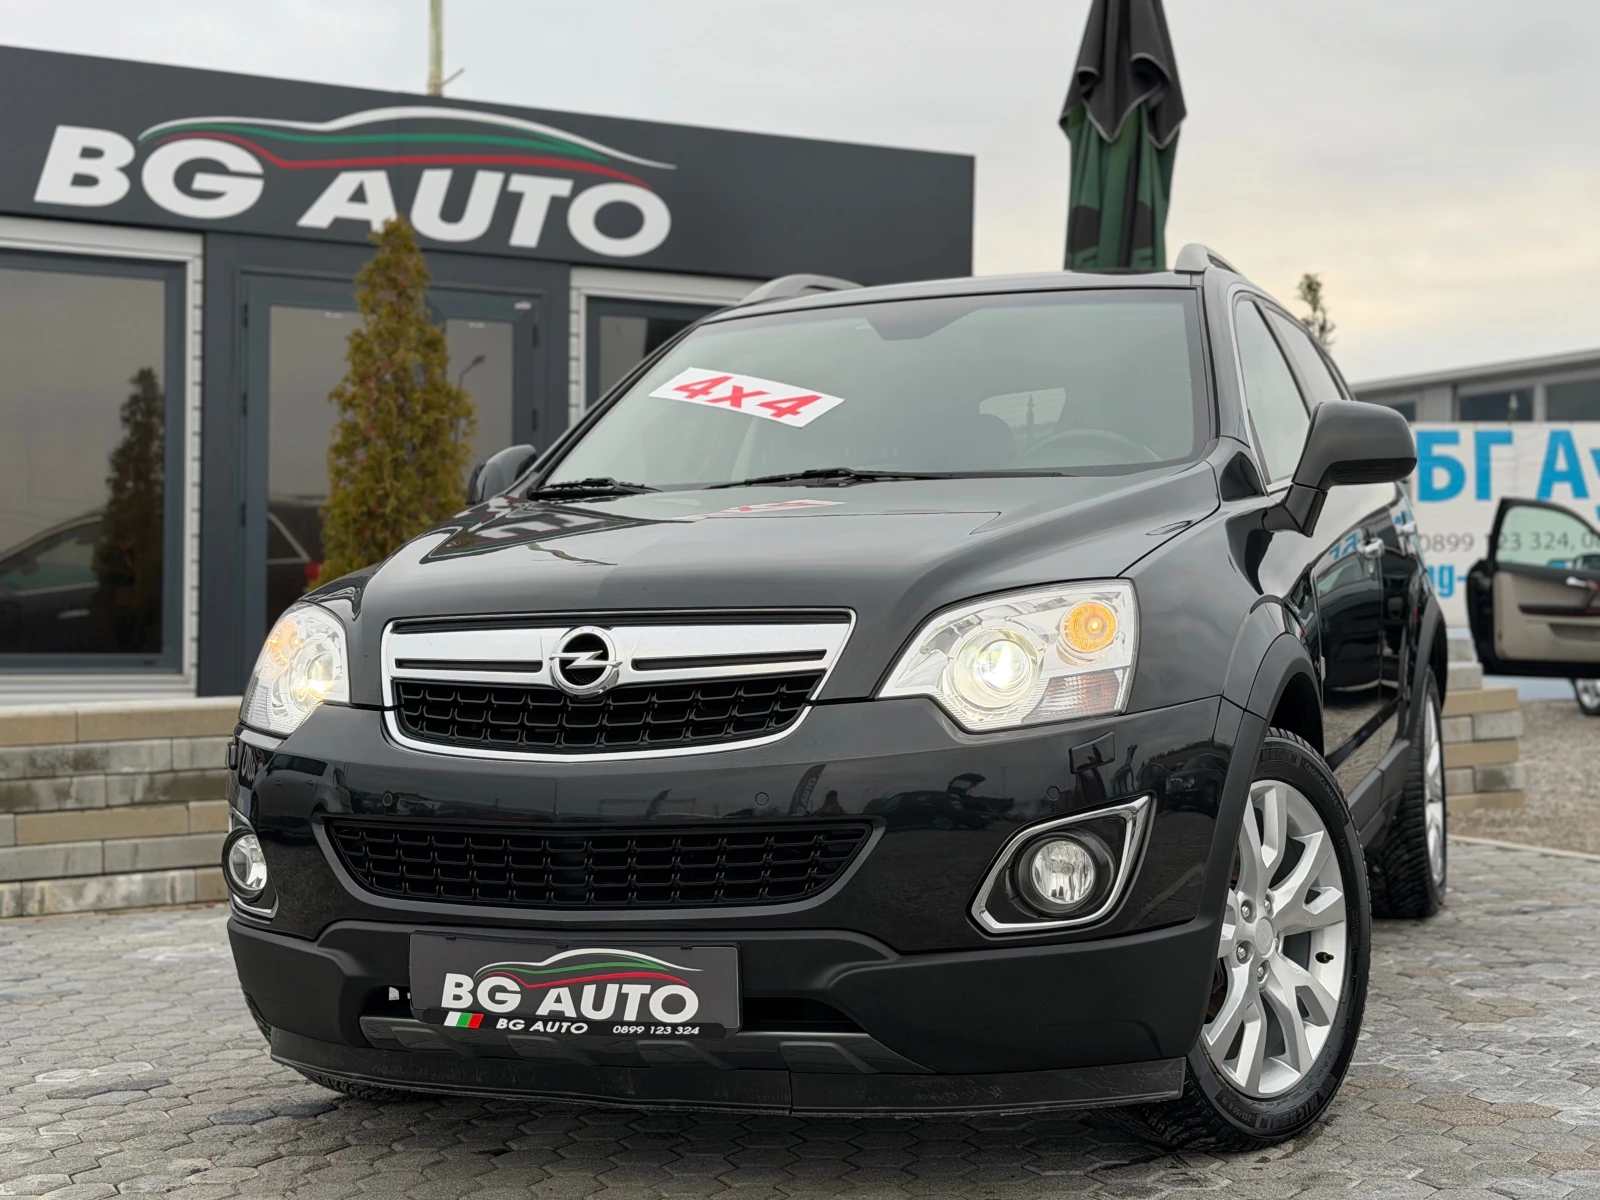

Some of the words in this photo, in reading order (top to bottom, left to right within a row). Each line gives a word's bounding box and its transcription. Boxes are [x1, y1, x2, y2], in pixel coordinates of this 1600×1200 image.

[34, 125, 265, 219] BG
[297, 169, 672, 256] AUTO
[1416, 430, 1513, 502] БГ
[440, 973, 521, 1013] BG
[536, 983, 699, 1023] AUTO
[496, 1018, 525, 1031] BG
[529, 1020, 588, 1034] AUTO
[613, 1025, 645, 1034] 0899
[649, 1026, 672, 1035] 123
[675, 1026, 700, 1035] 324
